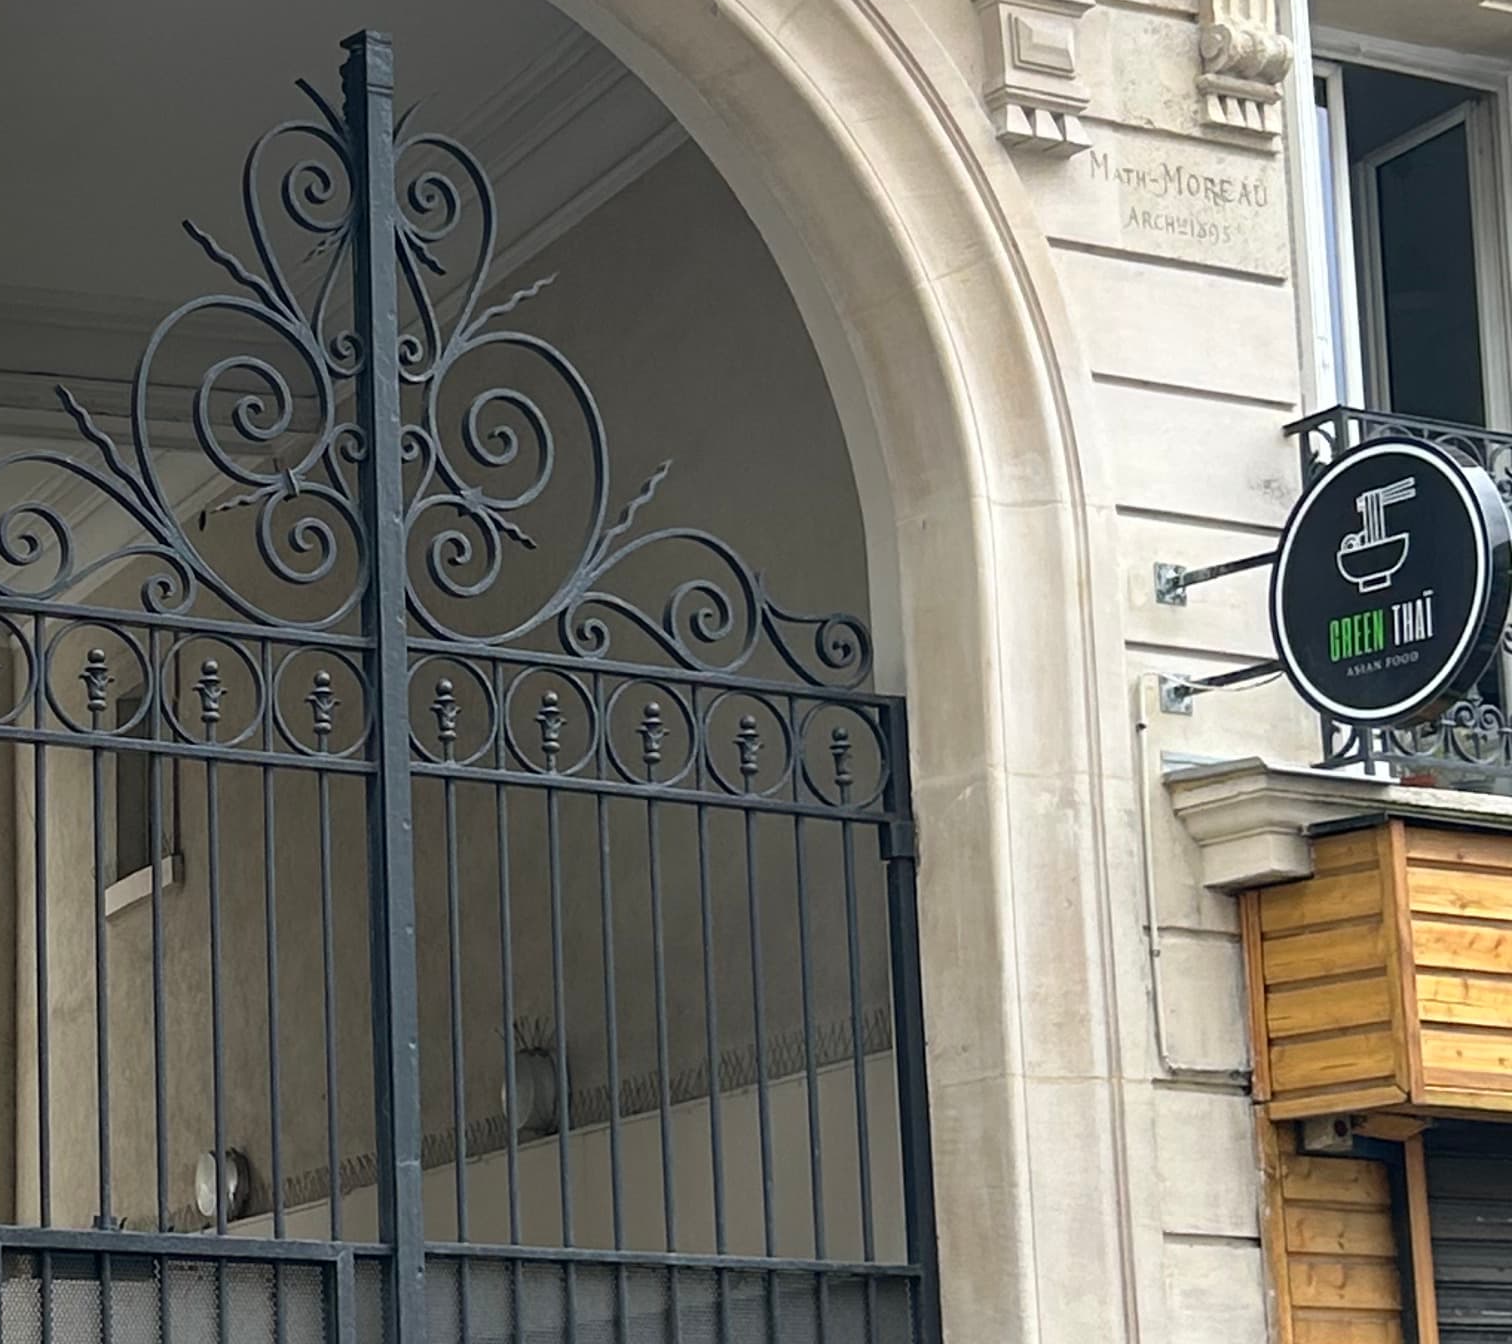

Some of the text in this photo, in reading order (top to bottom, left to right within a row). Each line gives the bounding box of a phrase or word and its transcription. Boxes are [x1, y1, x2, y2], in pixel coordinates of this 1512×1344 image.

[1329, 608, 1385, 663] GREEN
[1346, 650, 1420, 677] ASIAN FOOD
